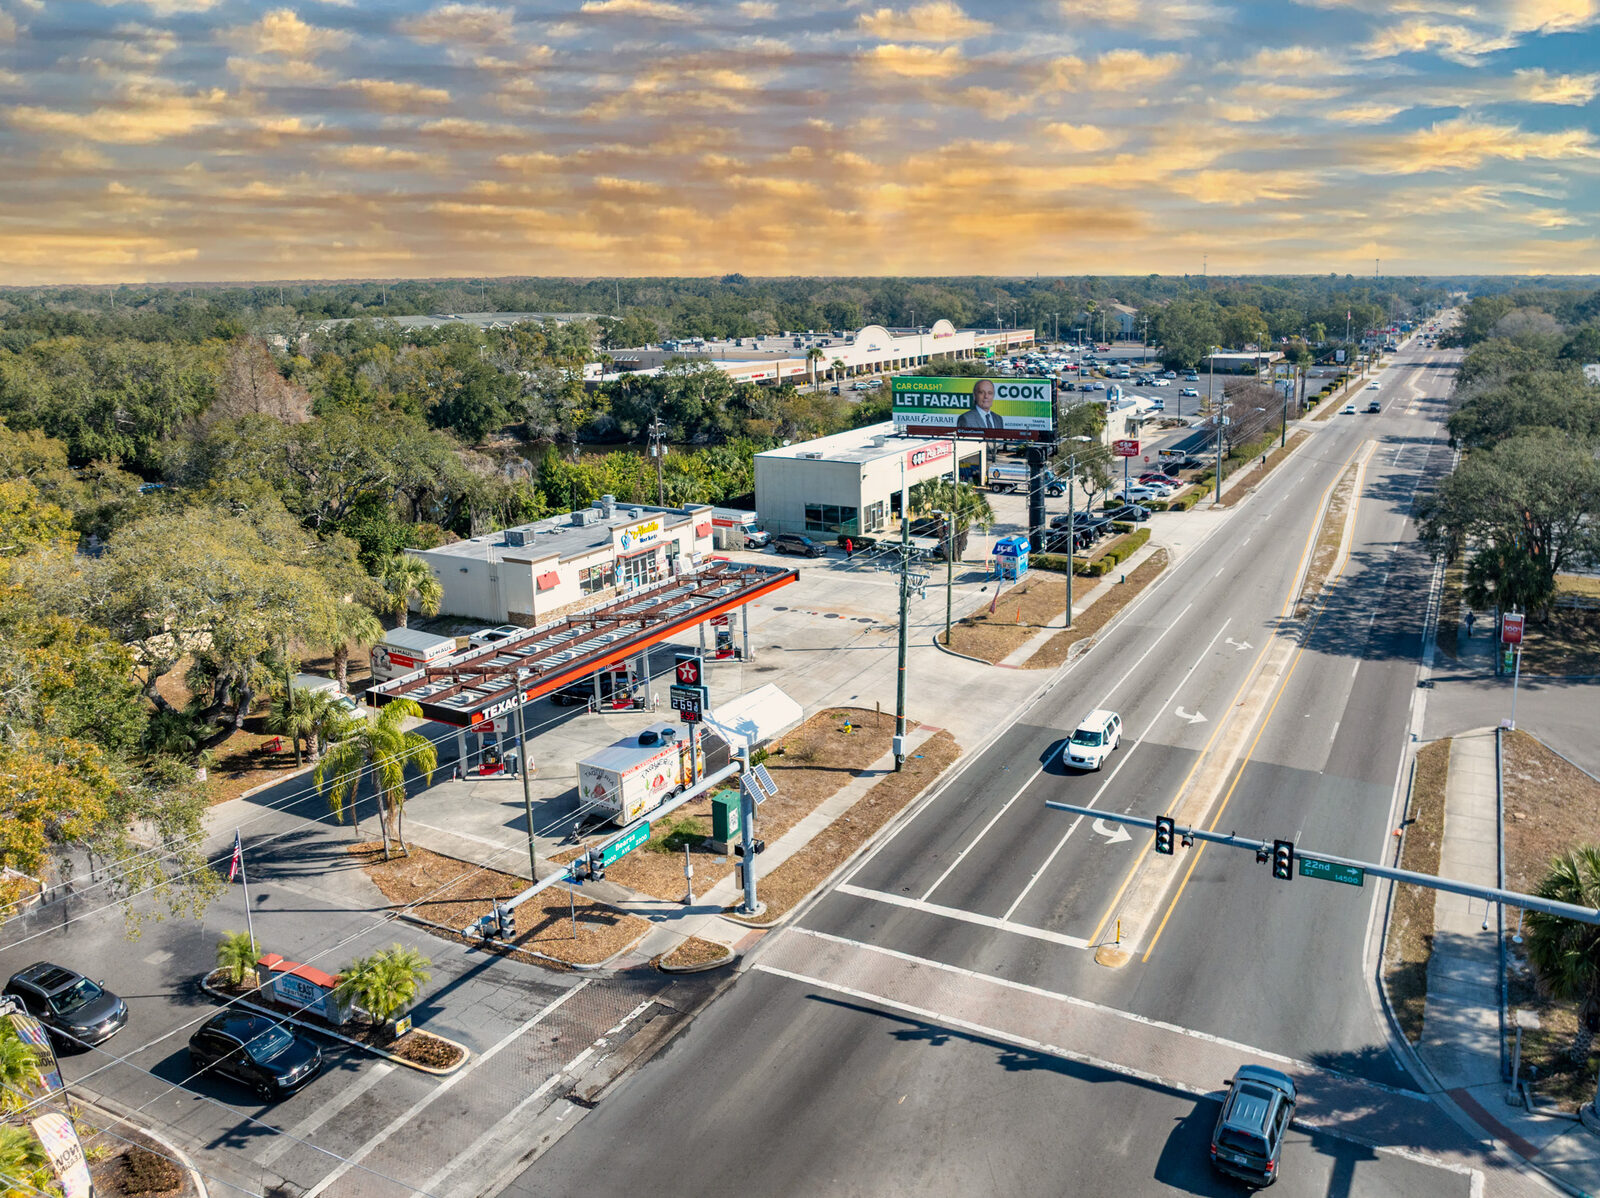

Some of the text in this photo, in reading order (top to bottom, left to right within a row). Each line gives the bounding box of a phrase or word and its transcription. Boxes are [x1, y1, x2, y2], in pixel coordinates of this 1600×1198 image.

[913, 383, 943, 391] CRASH?
[998, 385, 1045, 400] COOK
[896, 393, 970, 408] LET FARAH
[997, 545, 1013, 553] ICE
[482, 691, 528, 721] TEXACO
[615, 834, 636, 851] Bearss
[621, 845, 631, 855] AVE
[1304, 860, 1330, 871] 22nd
[1335, 874, 1359, 884] 14500
